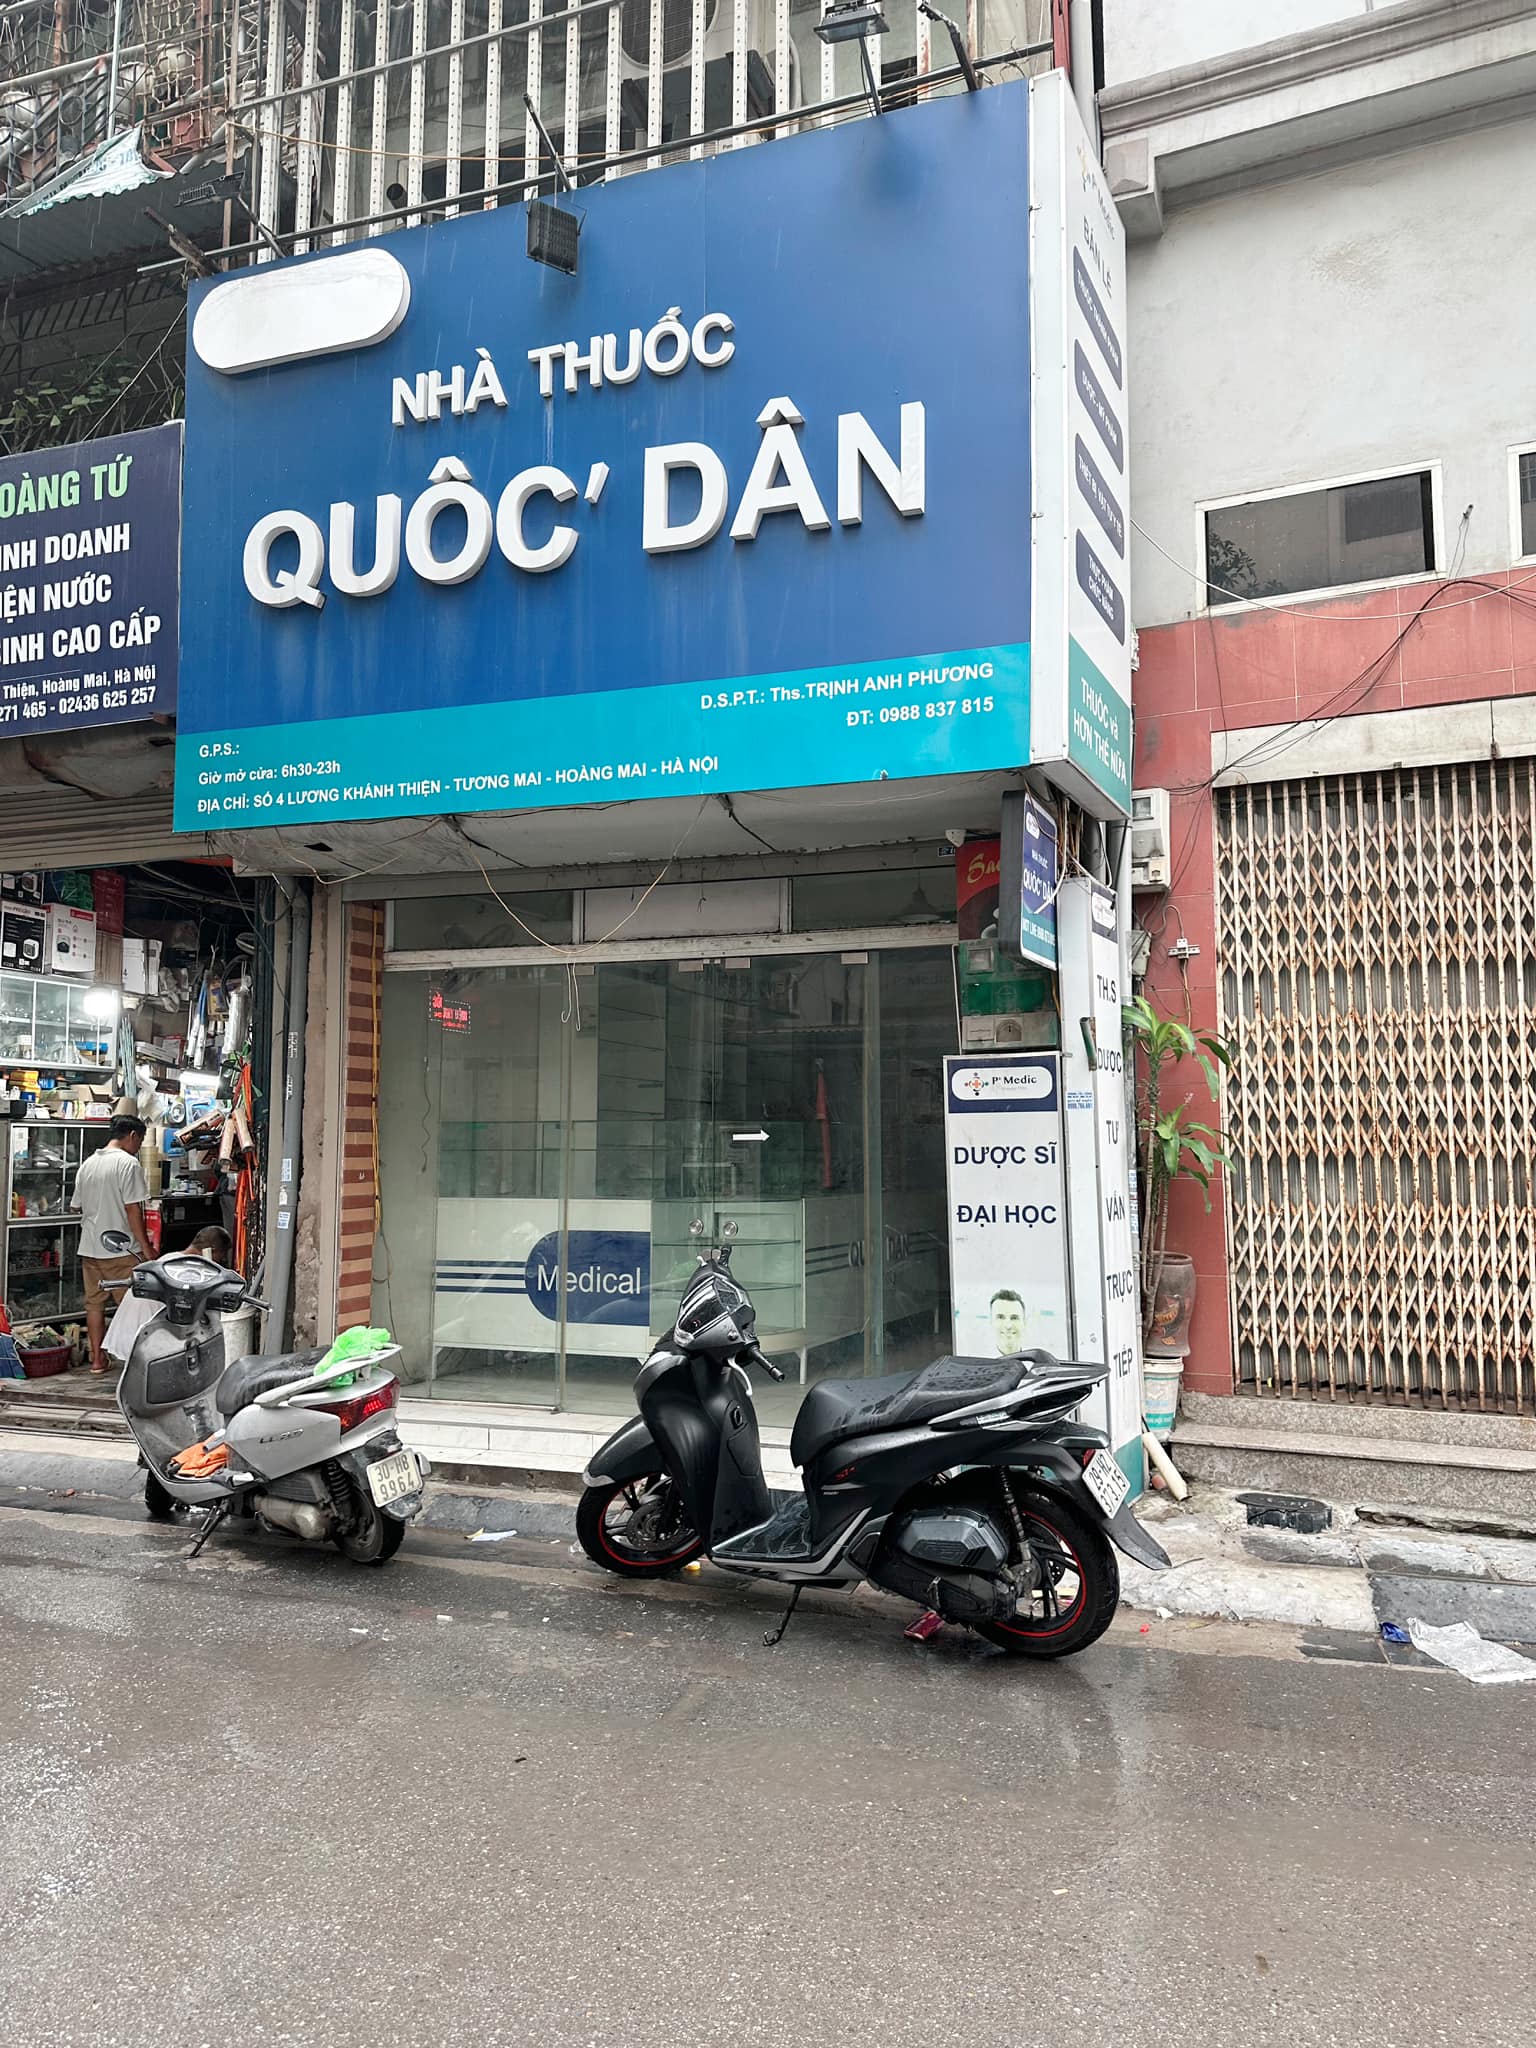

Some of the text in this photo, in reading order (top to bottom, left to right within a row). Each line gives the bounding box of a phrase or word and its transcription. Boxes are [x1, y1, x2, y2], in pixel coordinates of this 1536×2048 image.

[391, 305, 736, 427] NHÀ THUỐC
[90, 453, 133, 501] TỨ
[642, 396, 926, 555] DÂN
[44, 522, 131, 564] DOANH
[43, 571, 112, 612] NƯỚC
[52, 624, 101, 658] CAO
[109, 606, 161, 649] CẤP
[3, 664, 156, 700] Thiện, Hoàng Mai, Hà Nội
[700, 689, 765, 710] D.S.P.T.:
[863, 673, 903, 692] ANH
[907, 662, 994, 688] PHƯƠNG
[22, 701, 46, 719] 465
[58, 693, 99, 714] 02436
[102, 689, 128, 709] 625
[130, 685, 156, 705] 257
[846, 696, 994, 727] ĐT: 0988 837 815
[1080, 677, 1109, 729] THUỐC
[1073, 708, 1093, 751] HƠN
[199, 742, 240, 758] G.P.S.:
[197, 798, 220, 815] ĐỊA
[223, 791, 250, 810] CHỈ:
[253, 790, 273, 808] SỐ
[276, 794, 284, 806] 4
[287, 787, 339, 805] LƯƠNG
[343, 781, 394, 801] KHÁNH
[397, 779, 441, 798] THIỆN
[453, 775, 510, 792] TƯƠNG
[513, 771, 542, 787] MAI
[555, 765, 613, 783] HOÀNG
[617, 762, 647, 779] MAI
[661, 756, 685, 775] HÀ
[689, 755, 719, 775] NỘI
[198, 760, 341, 785] Giờ mở cửa: 6h30-23h
[1003, 1074, 1037, 1085] Medic
[1097, 1047, 1122, 1077] DƯỢC
[1106, 1119, 1119, 1144] TƯ
[954, 1141, 1057, 1169] DƯỢC SĨ
[956, 1204, 1057, 1229] ĐẠI HỌC
[537, 1264, 641, 1295] Medical
[1106, 1269, 1133, 1303] TRỰC
[1112, 1343, 1133, 1380] TIẾP
[379, 1471, 415, 1501] 9964
